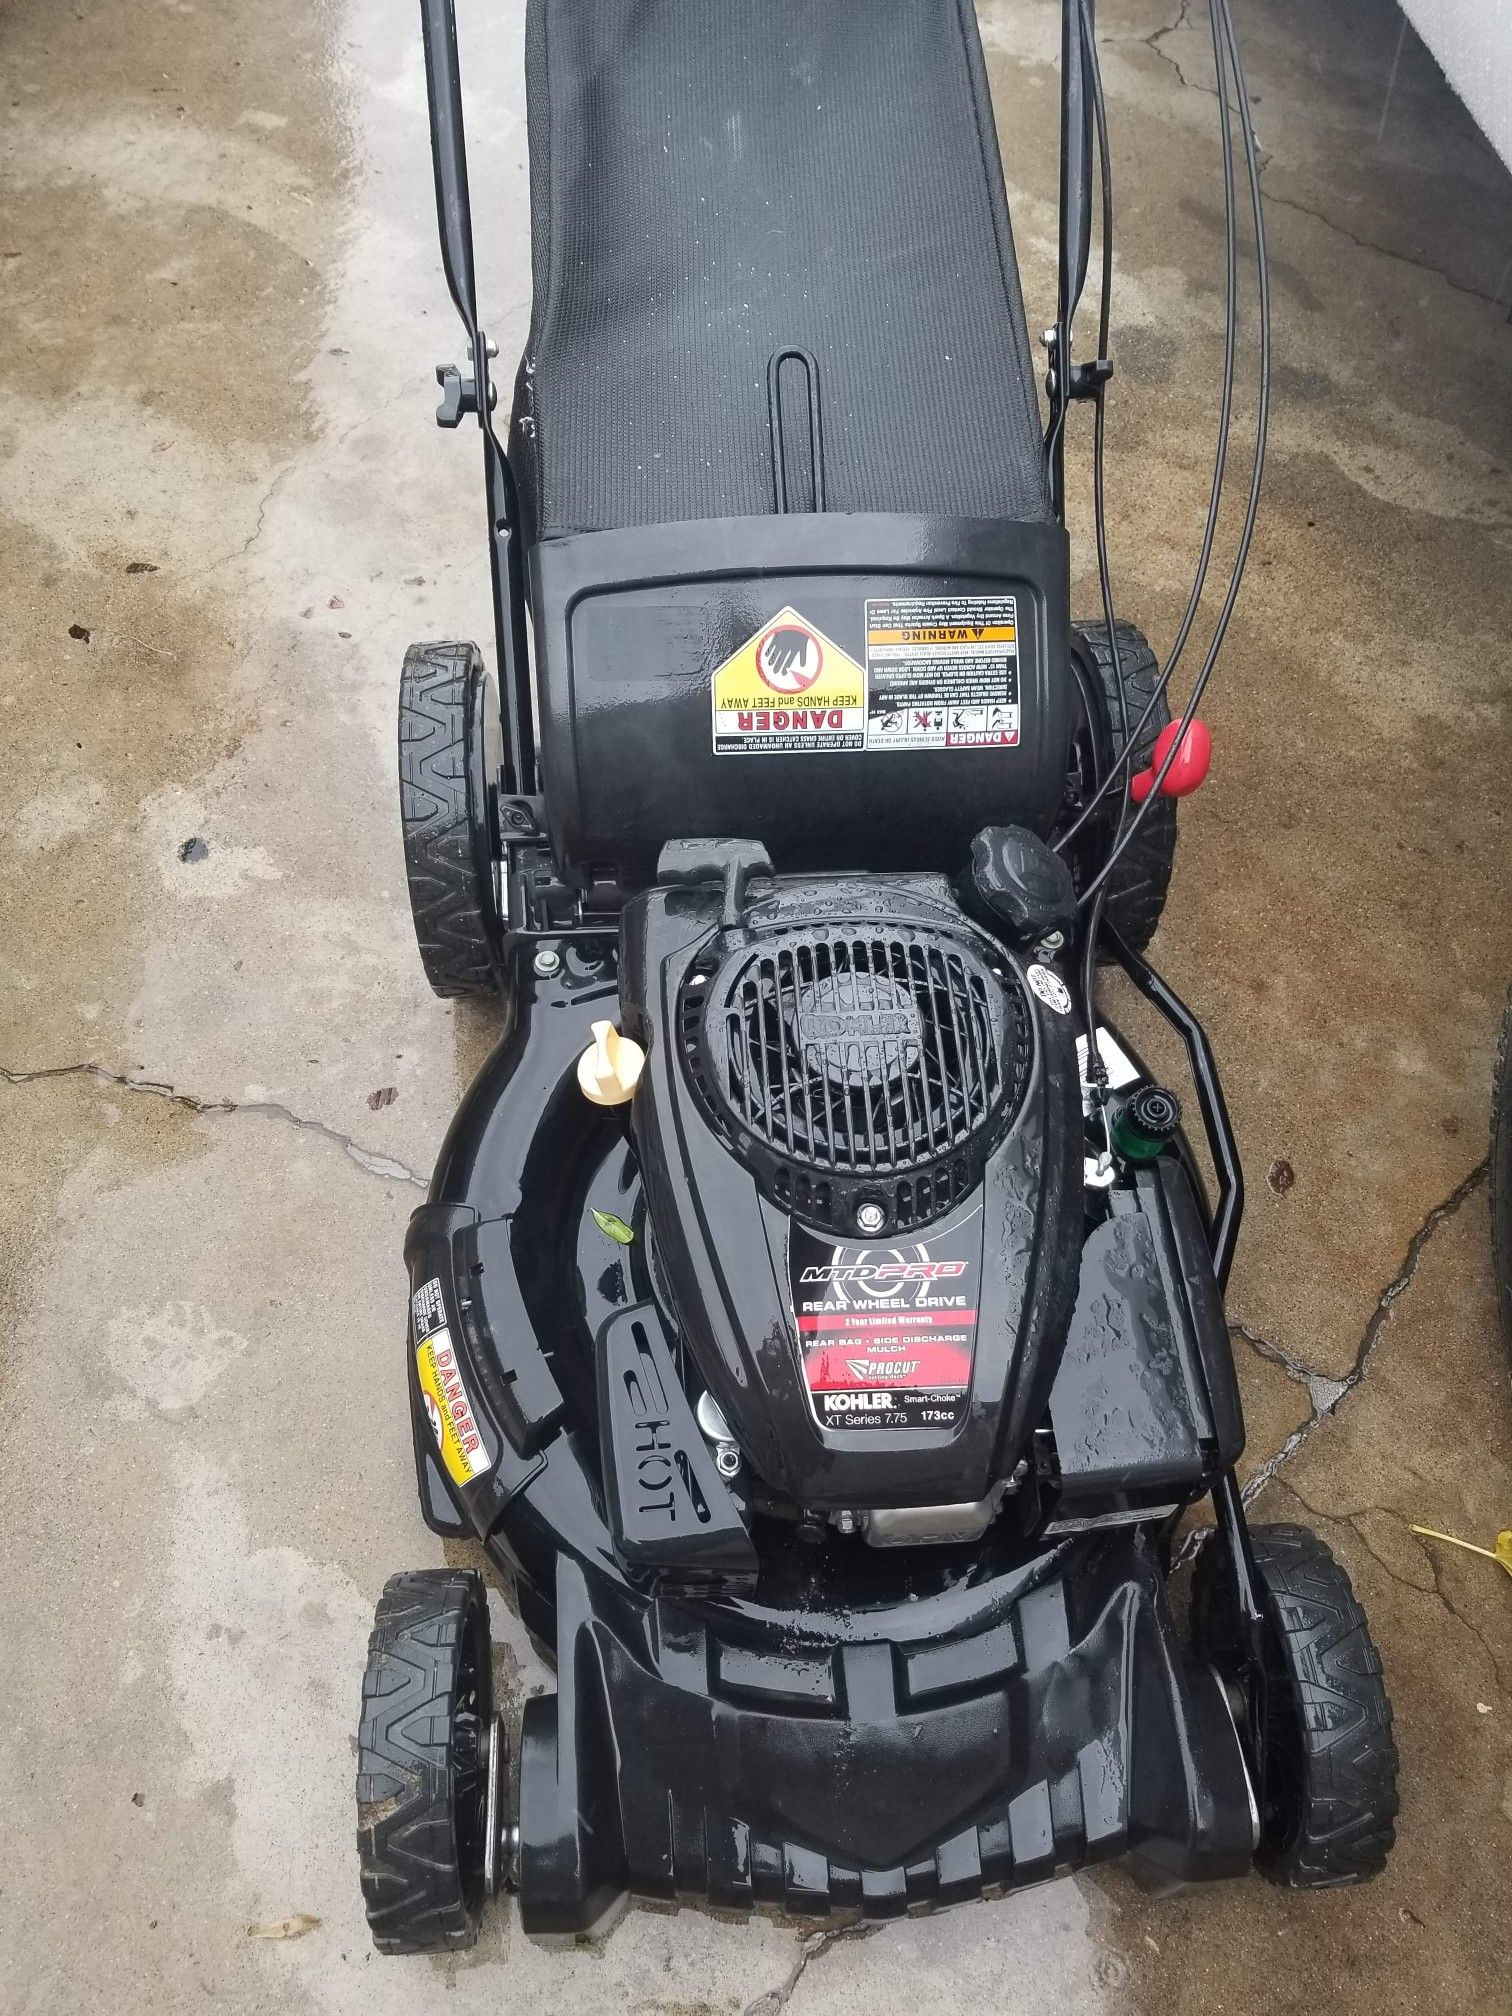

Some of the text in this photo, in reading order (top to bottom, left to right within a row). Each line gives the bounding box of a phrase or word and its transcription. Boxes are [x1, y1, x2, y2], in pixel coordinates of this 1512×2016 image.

[902, 630, 967, 640] WARNING
[721, 695, 856, 709] KEEP HANDS and FEET AWAY
[738, 710, 842, 730] DANGER
[949, 733, 1001, 744] DANGER
[802, 1296, 966, 1312] REAR WHEEL DRIVE
[436, 1300, 444, 1323] OPERATE
[851, 1318, 868, 1326] Year
[869, 1317, 896, 1325] Limited
[898, 1316, 932, 1324] Warranty
[874, 1337, 898, 1345] SIDE
[902, 1335, 967, 1343] DISCHARGE
[868, 1361, 919, 1374] PROCUT
[436, 1348, 480, 1454] DANGER
[426, 1344, 437, 1369] KEEP
[432, 1371, 446, 1404] HANDS
[441, 1404, 452, 1421] and
[447, 1421, 461, 1445] FEET
[456, 1446, 472, 1473] AWAY
[826, 1411, 955, 1425] XT Series 7.75 173cc
[634, 1419, 676, 1522] HOT
